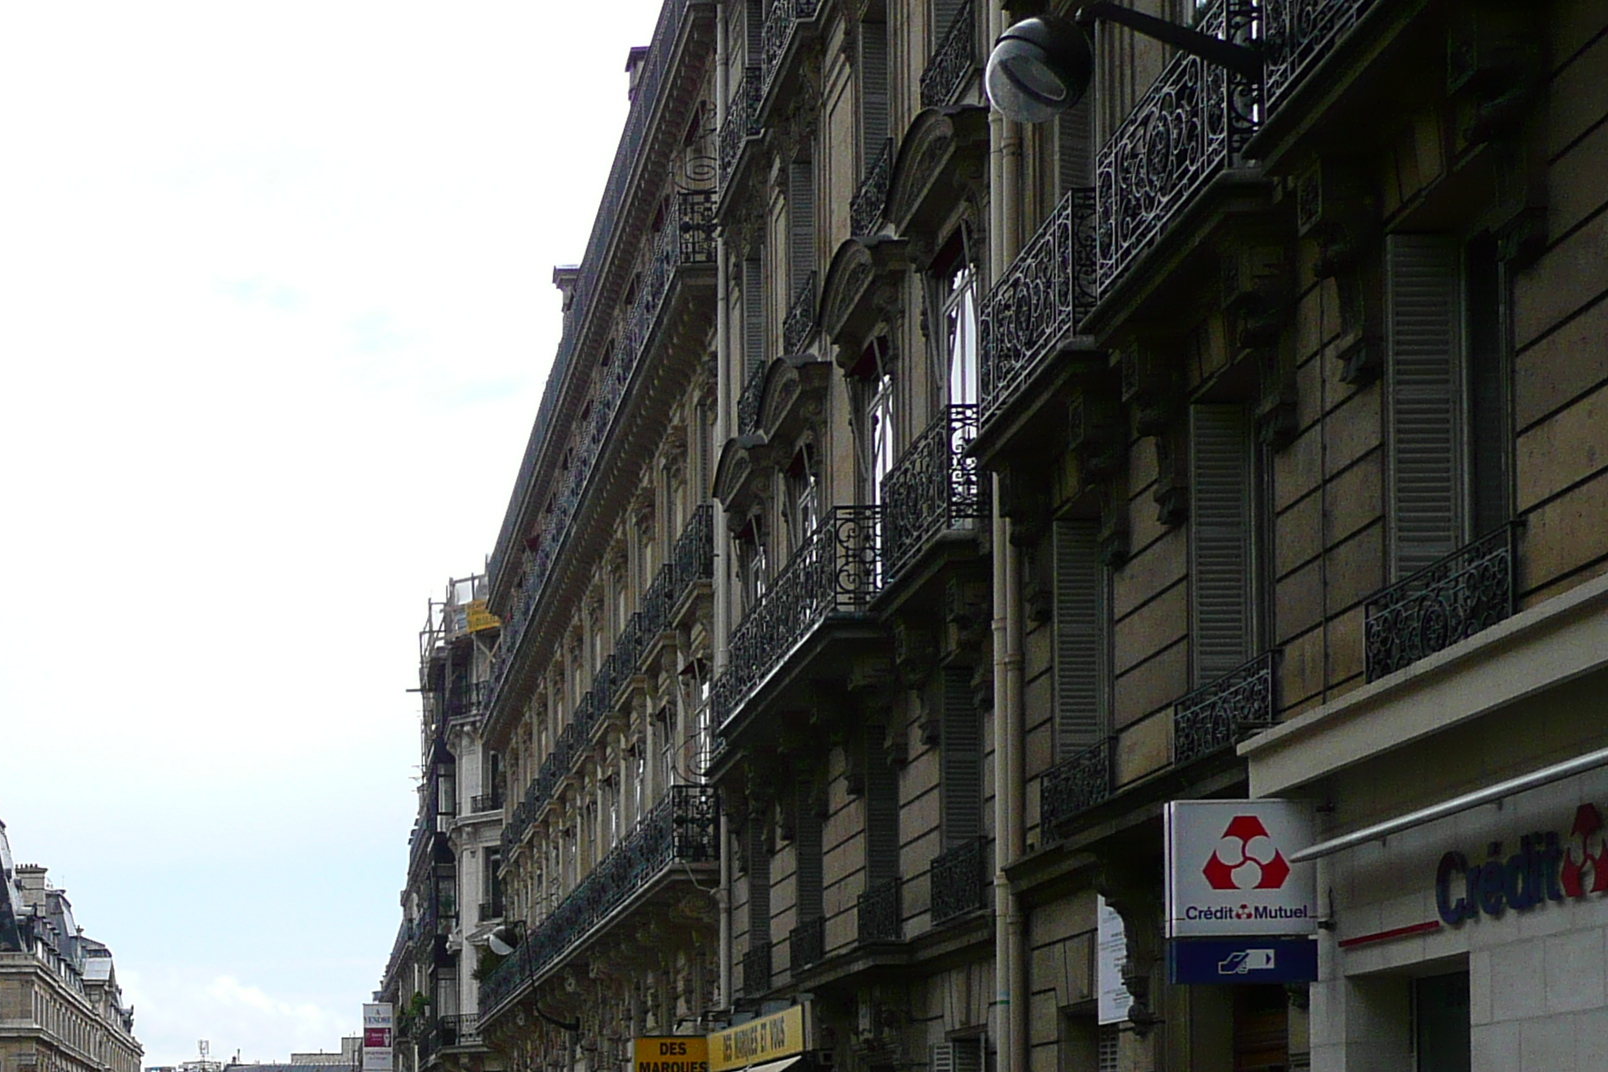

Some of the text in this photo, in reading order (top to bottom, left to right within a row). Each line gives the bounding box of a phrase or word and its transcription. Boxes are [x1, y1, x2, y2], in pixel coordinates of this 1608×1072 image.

[1435, 831, 1563, 925] Crédit
[1185, 904, 1308, 920] Crédit Mutuel
[659, 1042, 687, 1056] DES
